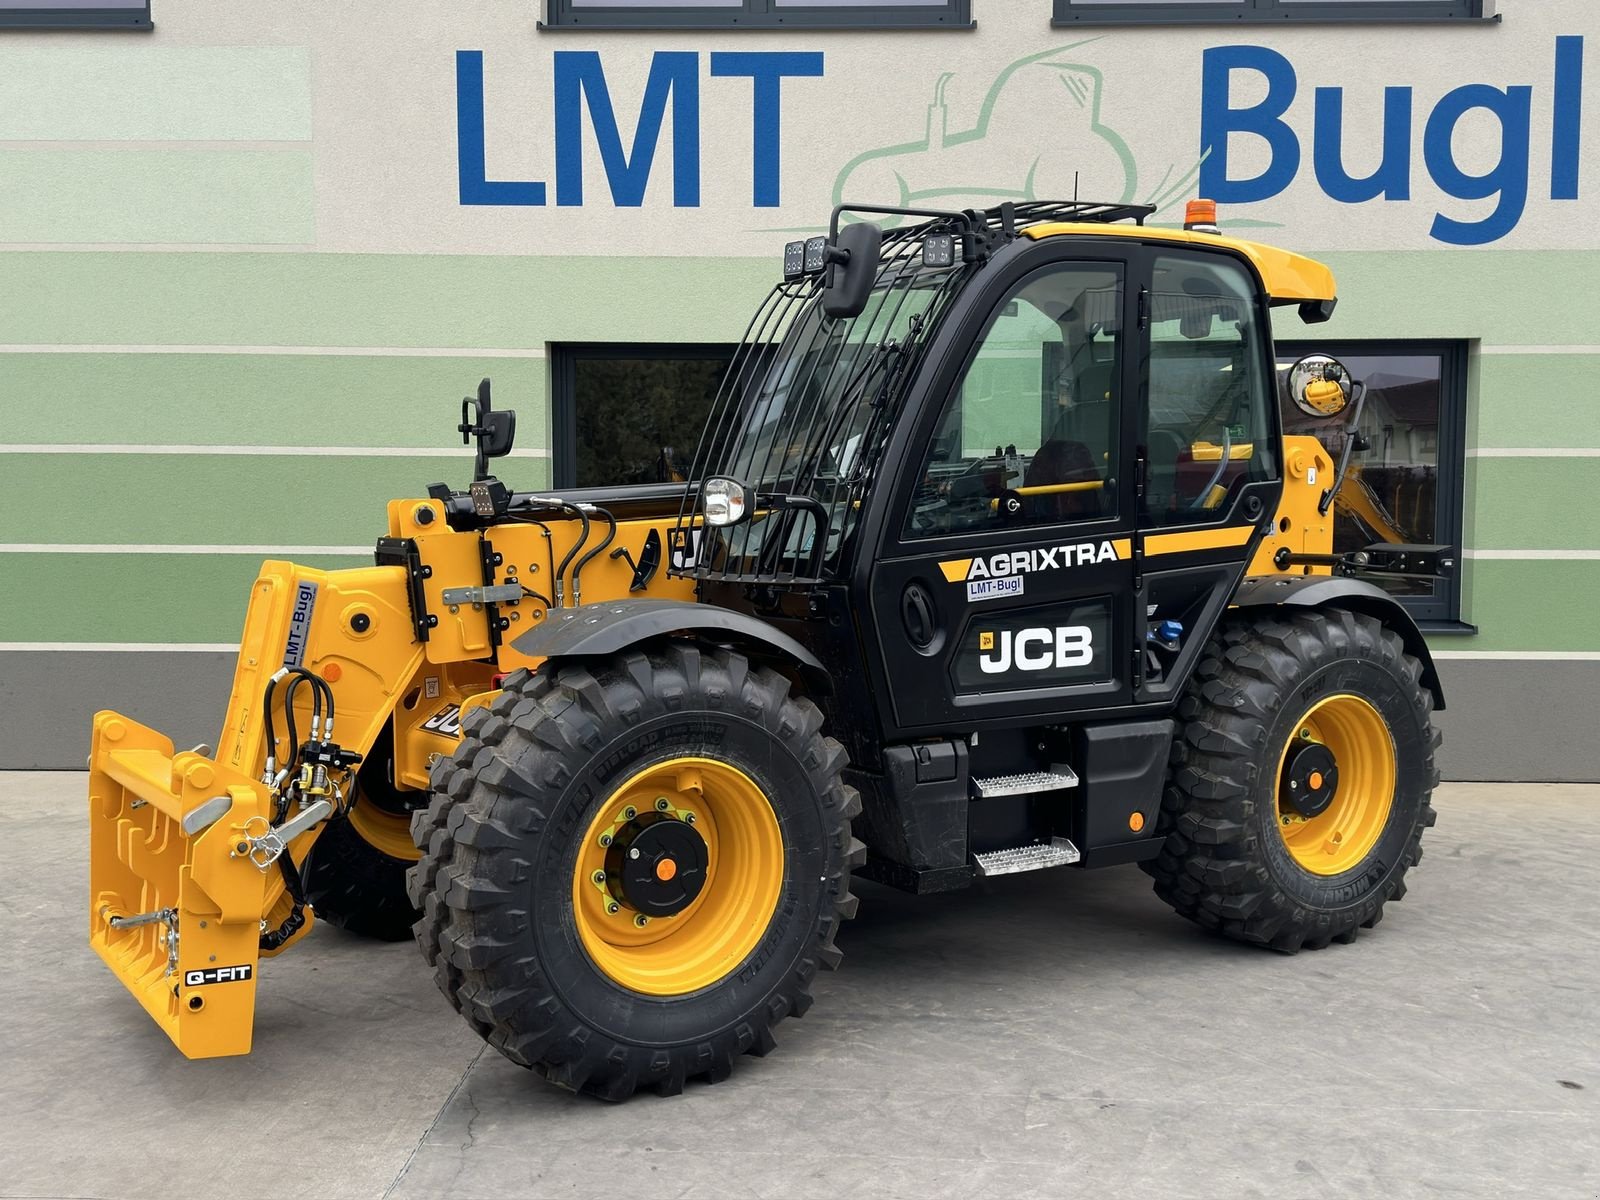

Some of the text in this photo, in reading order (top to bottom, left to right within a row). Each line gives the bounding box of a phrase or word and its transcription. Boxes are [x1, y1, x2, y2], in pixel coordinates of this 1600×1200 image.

[456, 36, 1583, 245] LMT Bugl
[967, 541, 1118, 580] AGRIXTRA
[970, 578, 1020, 595] LMT-Bugl
[284, 585, 312, 666] LMT-Bugl
[979, 625, 1094, 674] JCB
[425, 707, 460, 735] JC
[186, 965, 251, 985] Q-FIT
